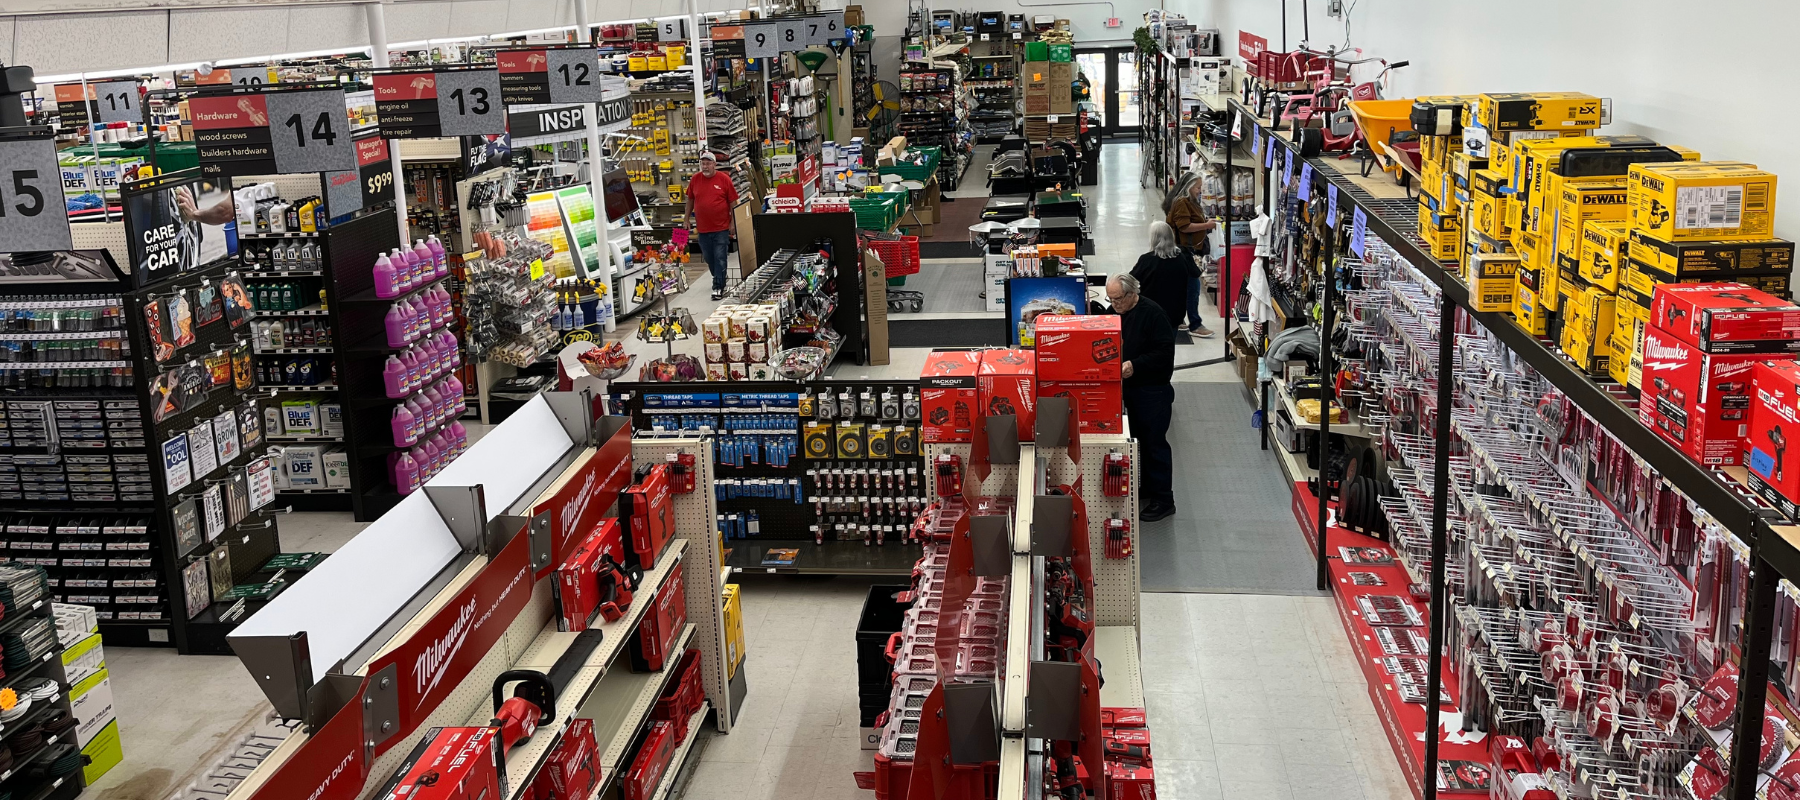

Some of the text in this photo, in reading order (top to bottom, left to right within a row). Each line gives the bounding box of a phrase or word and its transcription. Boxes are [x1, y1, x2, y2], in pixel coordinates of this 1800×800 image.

[665, 24, 673, 34] 5
[808, 25, 818, 36] 7
[828, 20, 836, 31] 6
[755, 33, 766, 48] 9
[785, 29, 795, 42] 8
[558, 62, 590, 86] 12
[239, 76, 262, 92] 10
[378, 86, 397, 94] Tools
[105, 92, 130, 110] 11
[379, 102, 409, 111] engine oil
[450, 87, 490, 116] 13
[196, 112, 238, 120] Hardware
[1579, 106, 1596, 114] XR
[285, 112, 336, 148] 14
[382, 128, 412, 136] tire repair
[199, 132, 248, 142] wood screws
[201, 147, 268, 158] builders hardware
[362, 147, 381, 160] Special!
[470, 154, 487, 167] FLAG
[204, 165, 221, 173] nails
[62, 172, 84, 180] Blue
[64, 180, 84, 188] DEF
[1642, 176, 1664, 192] DEWALT
[0, 169, 44, 217] 5
[1562, 190, 1578, 204] DEWALT
[1583, 194, 1628, 204] DEWALT
[144, 224, 176, 244] CARE
[1584, 230, 1608, 248] DEWALT
[146, 238, 178, 254] FOR YOUR
[148, 248, 179, 270] CAR
[1521, 268, 1534, 280] FLEX
[1040, 332, 1070, 344] Milwaukee
[1644, 334, 1689, 360] Milwaukee
[1713, 360, 1756, 375] Milwaukee
[923, 390, 946, 398] Milwaukee
[1020, 378, 1033, 412] Milwaukee
[1758, 388, 1800, 424] M18 FUEL
[288, 411, 310, 419] Blue
[289, 418, 310, 426] DEF
[166, 439, 184, 452] WELCOME
[171, 450, 187, 464] OOL
[292, 462, 312, 472] DEF
[560, 469, 596, 538] Milwaukee
[474, 608, 492, 631] Nothing
[491, 598, 500, 612] but
[499, 581, 514, 602] HEAVY
[412, 599, 477, 693] Milwaukee
[78, 704, 112, 734] SPIDER TRAPS
[447, 740, 477, 773] FUEL
[306, 776, 331, 800] EAVY
